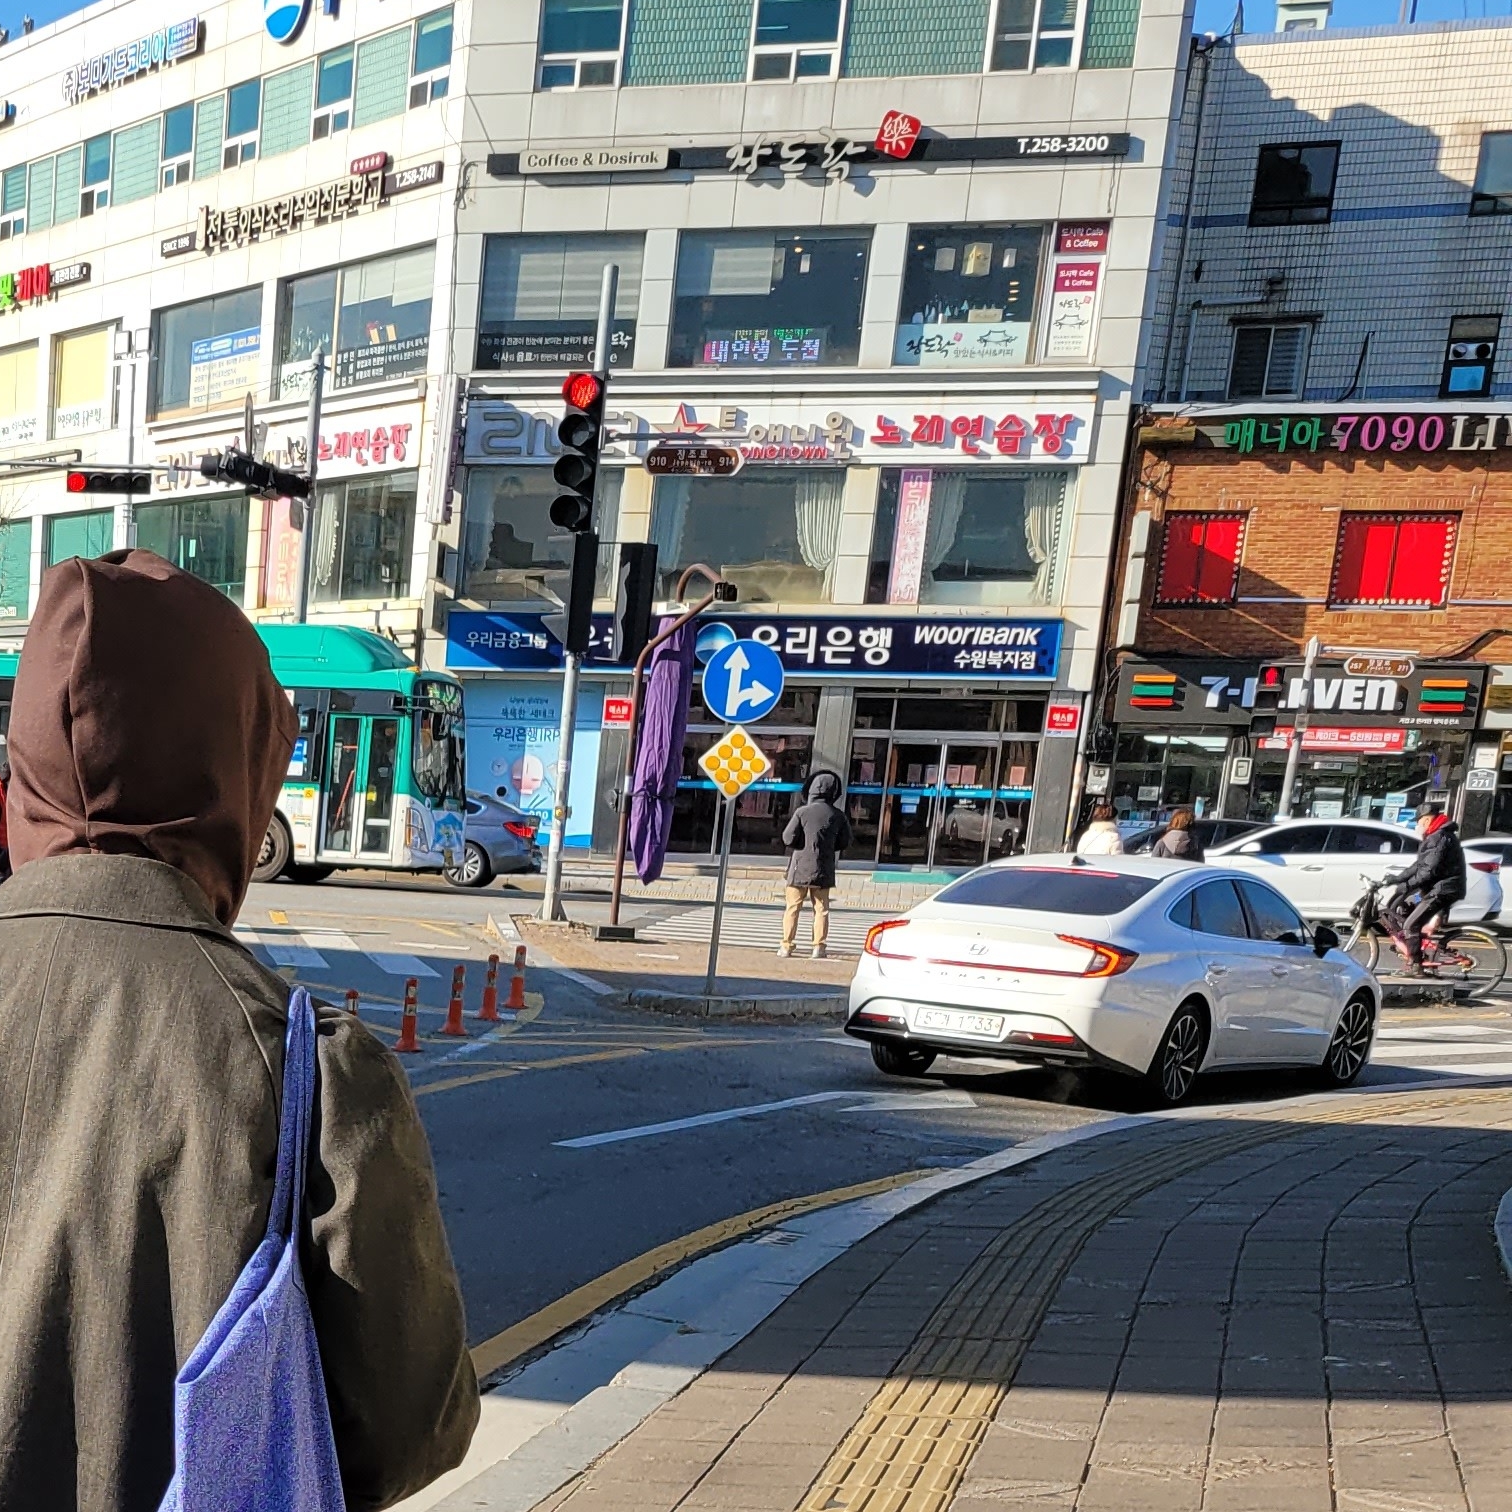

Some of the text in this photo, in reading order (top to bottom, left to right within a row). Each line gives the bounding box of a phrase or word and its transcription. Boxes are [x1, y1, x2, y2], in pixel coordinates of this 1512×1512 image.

[726, 126, 866, 182] 장도락
[1017, 134, 1110, 155] T.258-3200
[526, 145, 660, 168] Coffee & Dosirak
[1074, 239, 1098, 247] Coffee
[1085, 228, 1103, 236] Cafe
[906, 334, 956, 359] 장도락
[318, 423, 412, 466] 노래연습장
[869, 413, 1075, 456] 노래연습장
[1223, 417, 1326, 453] 매니아
[1335, 415, 1445, 452] 7090
[649, 456, 667, 467] 910
[466, 630, 548, 650] 우리금융그룹
[751, 625, 894, 667] 우리은행
[954, 650, 1037, 670] 수원북지점
[1472, 777, 1490, 788] 271
